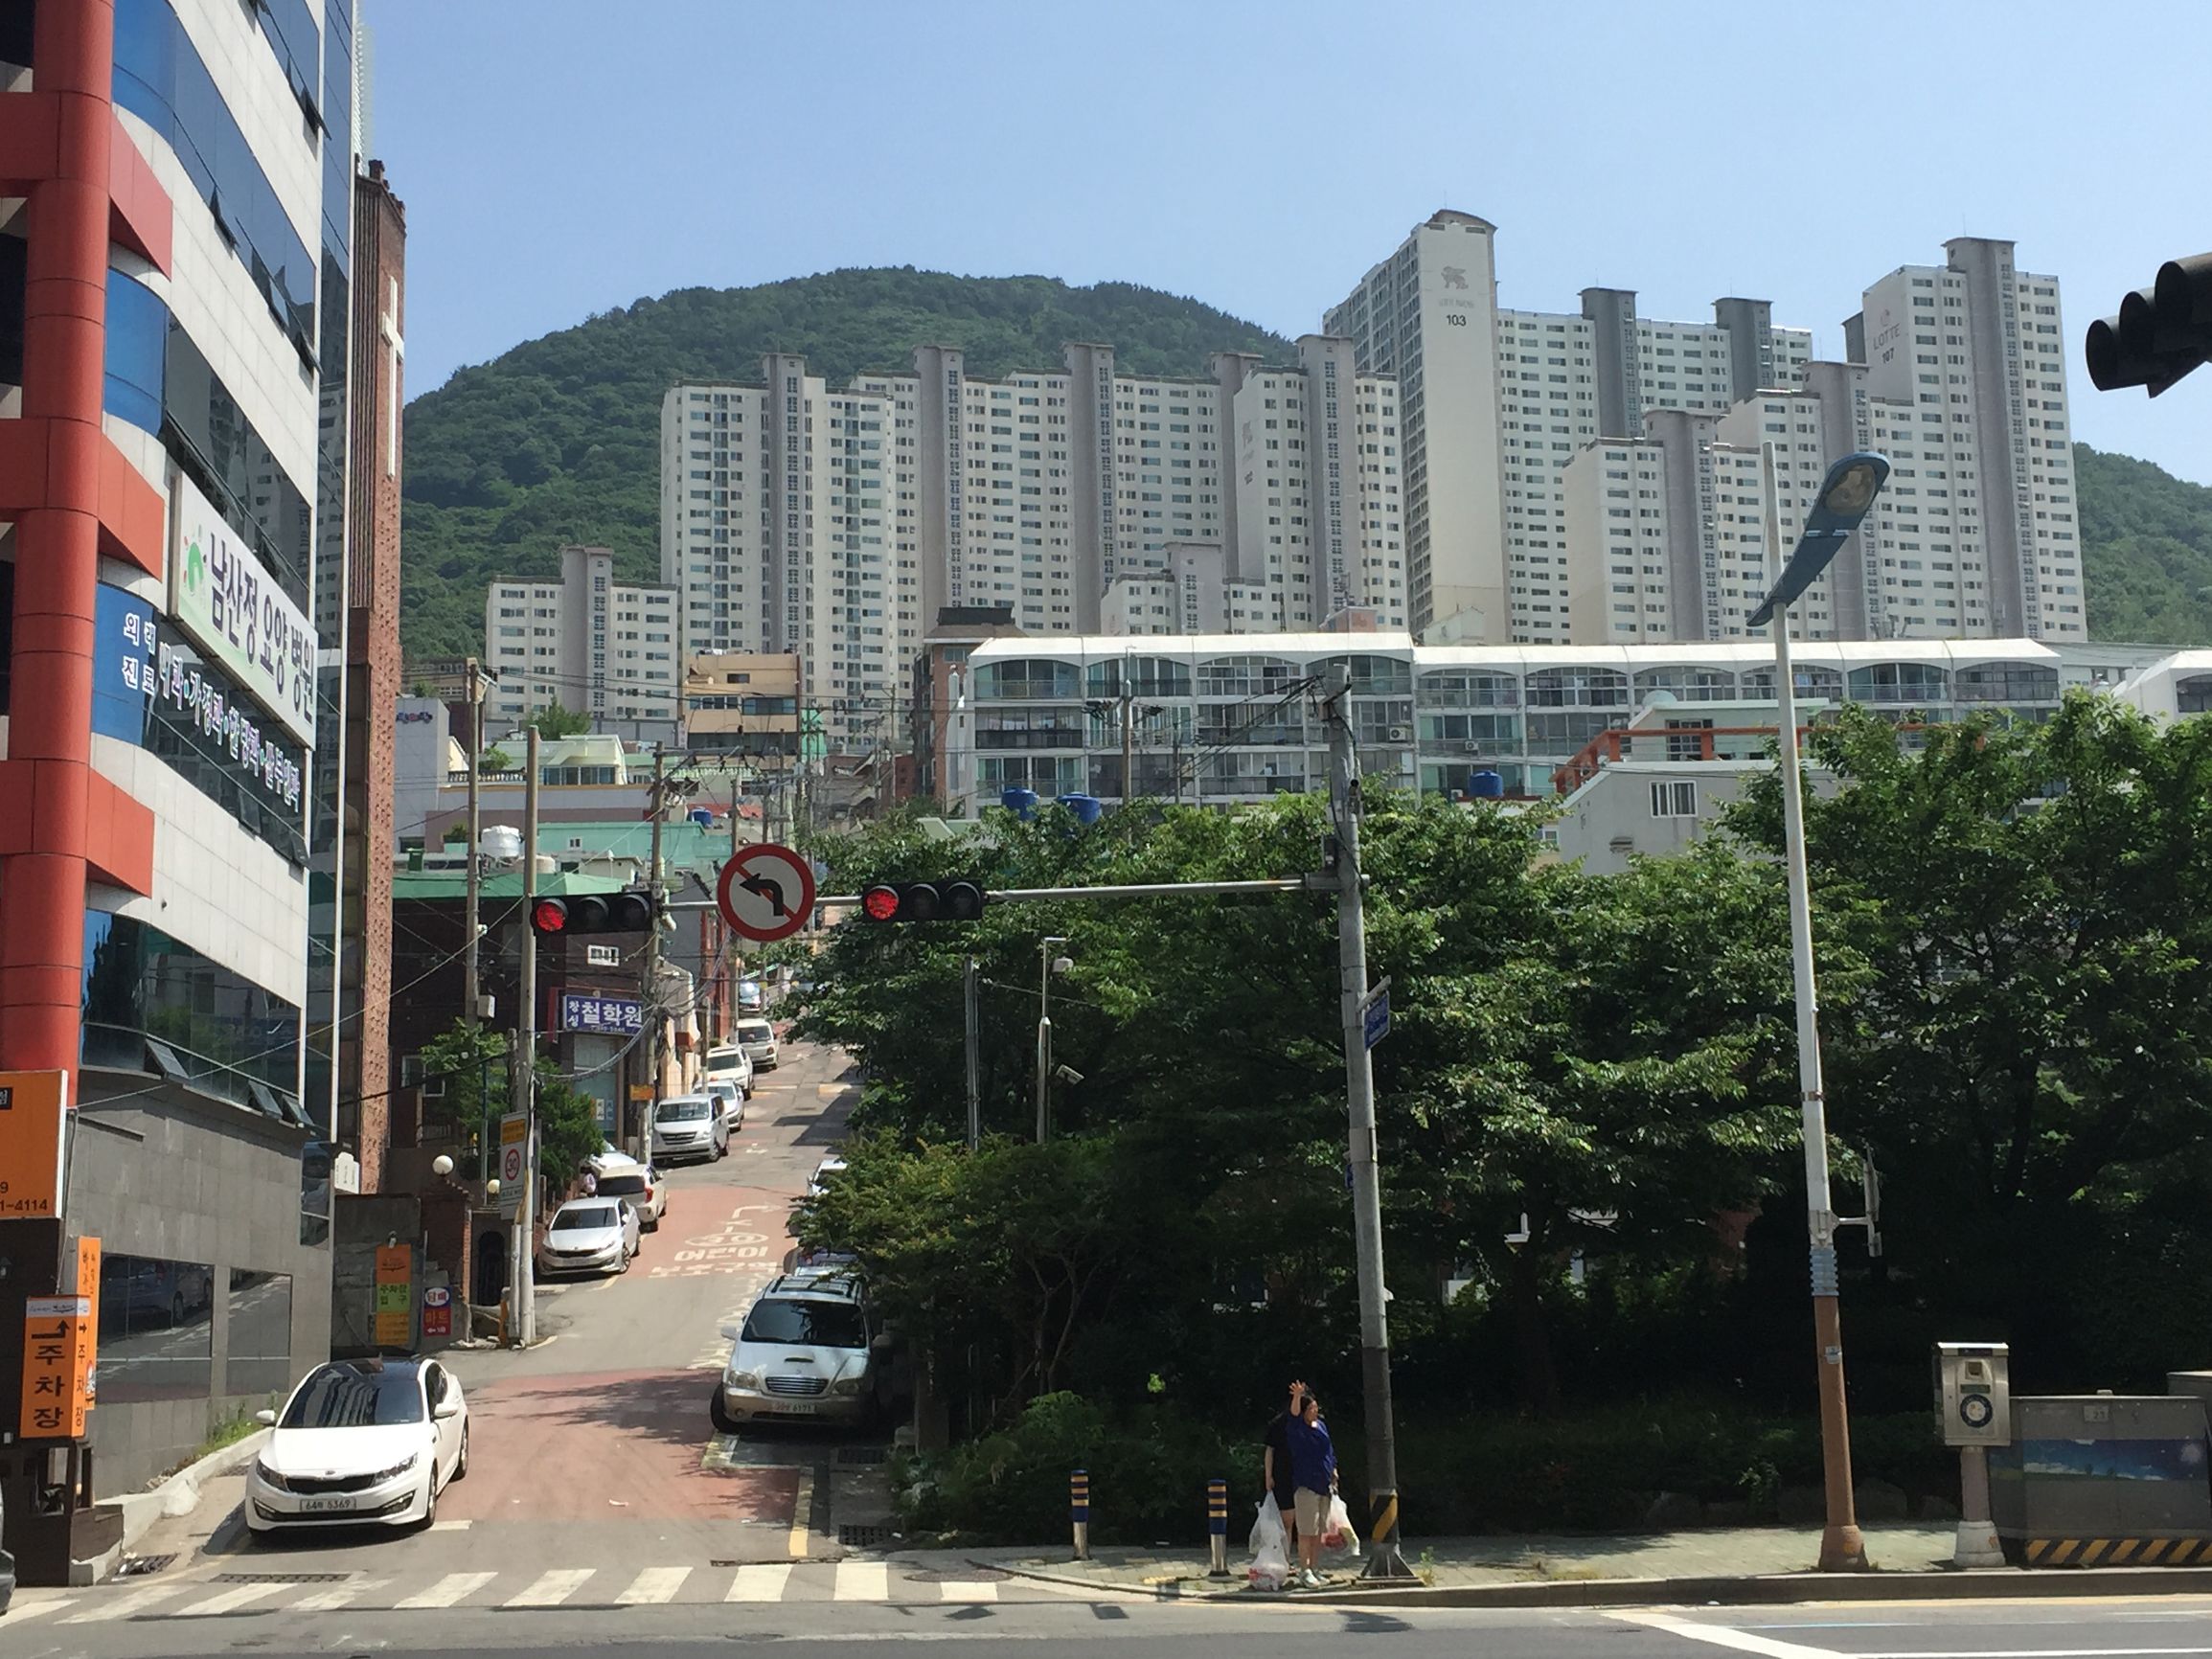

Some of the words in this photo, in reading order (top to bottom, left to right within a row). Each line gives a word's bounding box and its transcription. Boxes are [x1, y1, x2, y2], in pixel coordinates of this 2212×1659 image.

[1447, 314, 1467, 327] 103
[1873, 322, 1901, 351] LOTTE
[211, 533, 258, 666] 남산정
[260, 594, 287, 695] 요양
[291, 625, 314, 725] 병원
[122, 655, 155, 697] 진료
[582, 1001, 644, 1029] 철학원
[33, 1345, 65, 1430] 주차장
